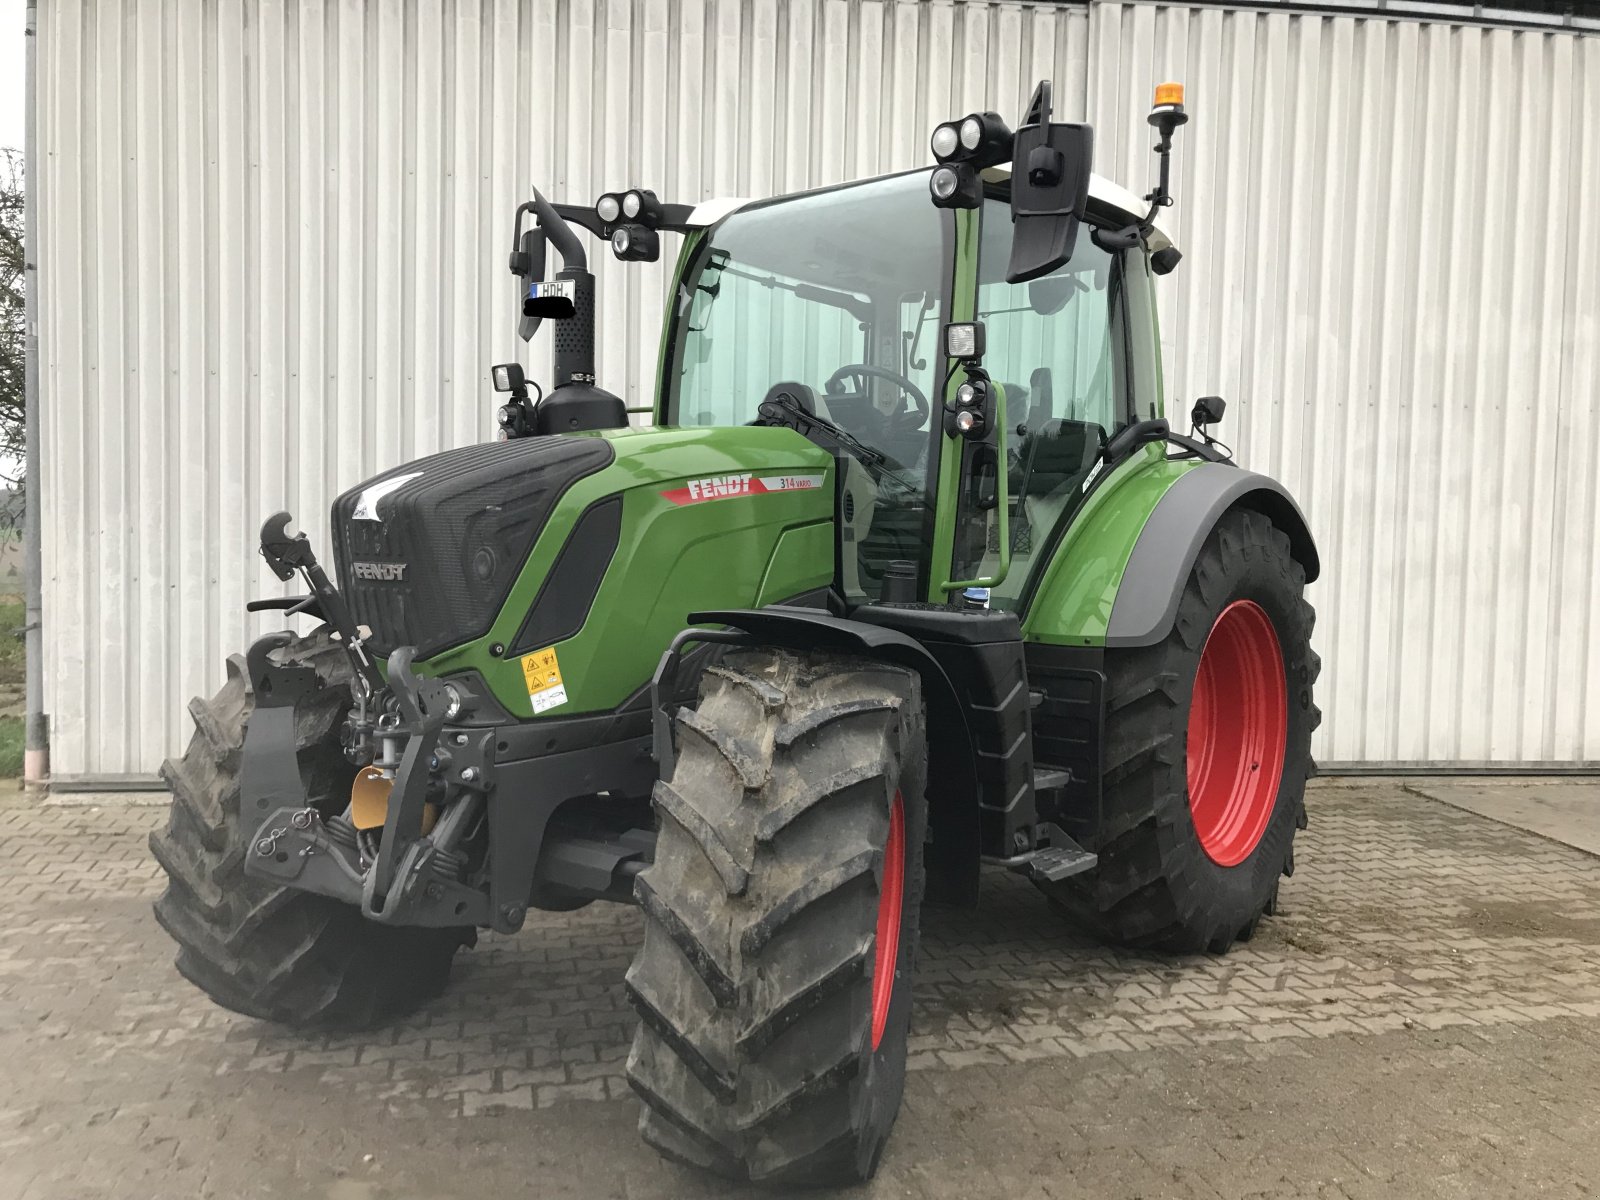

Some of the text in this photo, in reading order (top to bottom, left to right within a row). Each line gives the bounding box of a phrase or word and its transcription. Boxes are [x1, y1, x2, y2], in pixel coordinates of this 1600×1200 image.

[542, 283, 564, 297] HDH
[687, 473, 812, 500] FENDT 314 VARIO
[353, 562, 408, 581] FENDT
